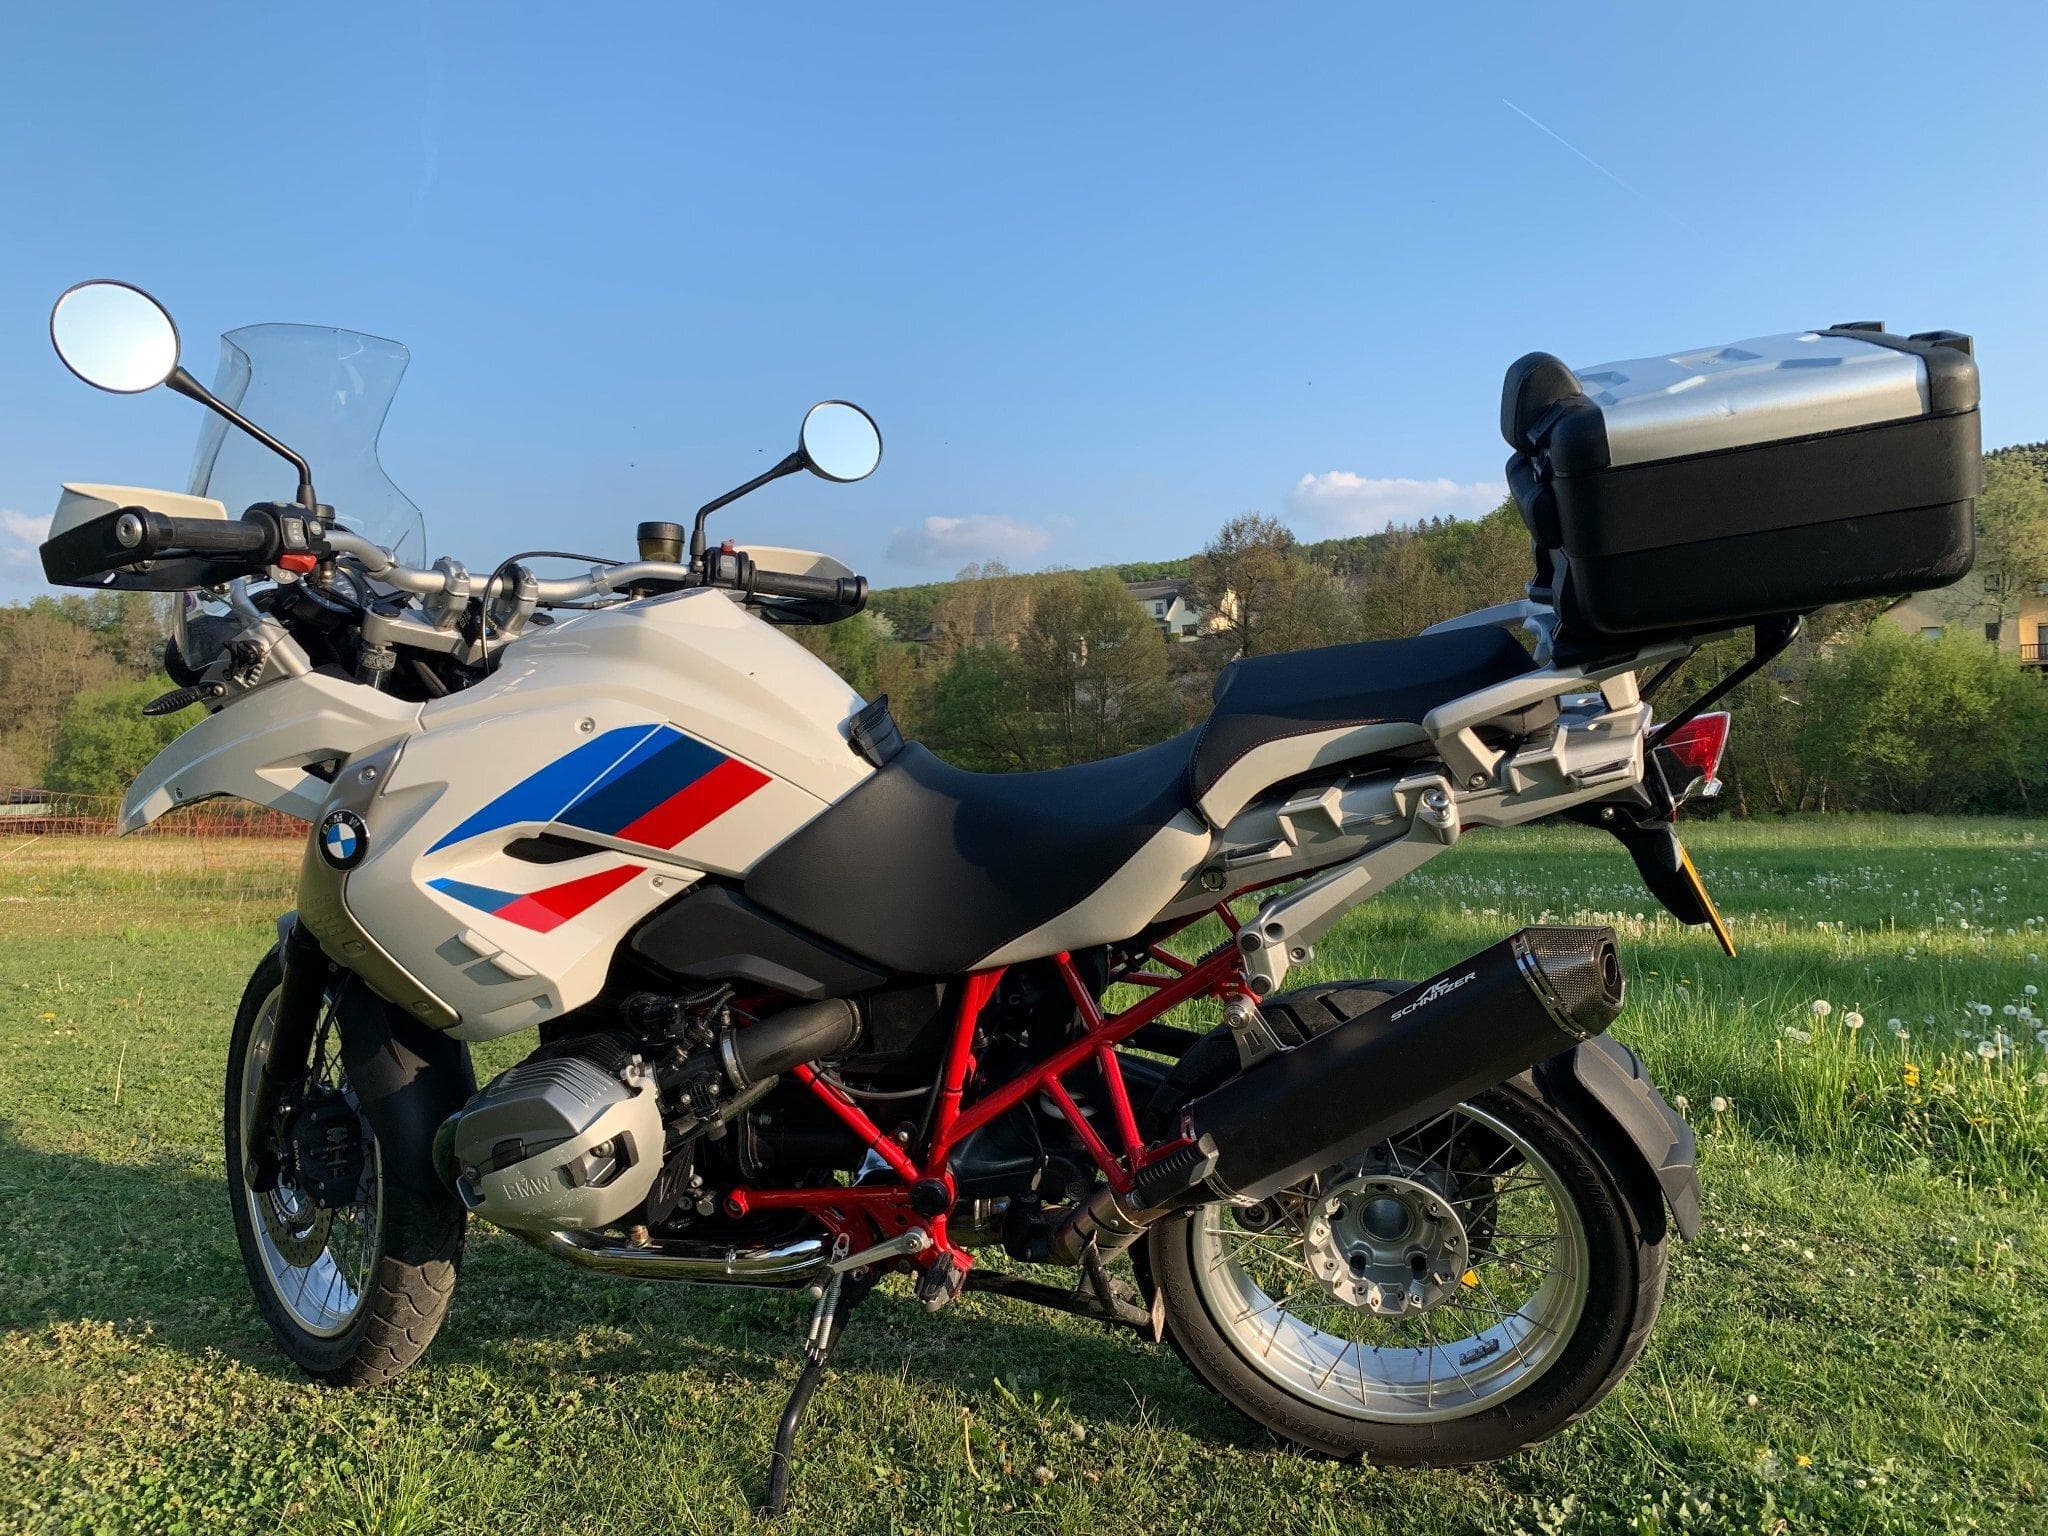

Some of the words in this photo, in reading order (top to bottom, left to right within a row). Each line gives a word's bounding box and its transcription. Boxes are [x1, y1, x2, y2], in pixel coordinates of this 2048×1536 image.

[322, 812, 361, 835] BMW
[1391, 972, 1477, 1021] SCHNITZER
[1416, 977, 1450, 1003] AC
[502, 1176, 552, 1200] BMW
